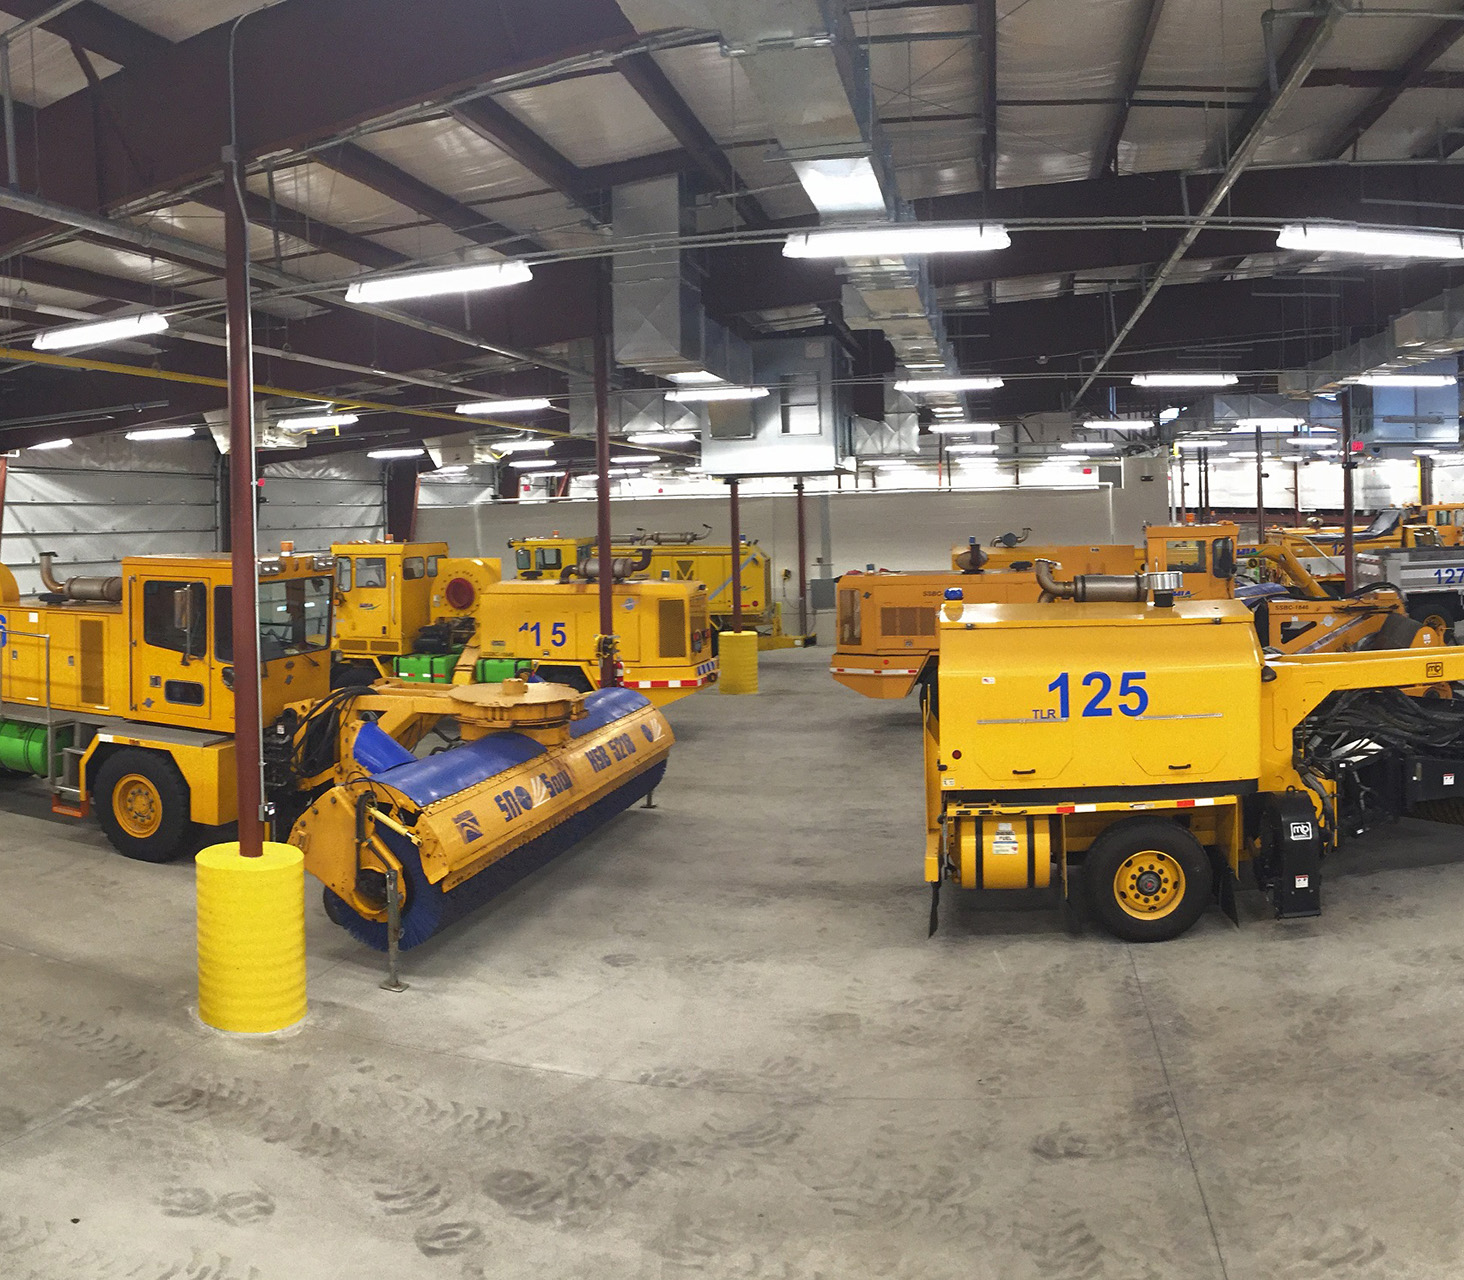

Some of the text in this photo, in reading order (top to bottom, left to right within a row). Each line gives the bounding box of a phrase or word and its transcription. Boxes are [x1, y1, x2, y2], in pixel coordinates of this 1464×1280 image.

[1332, 543, 1345, 556] 12
[1032, 671, 1149, 719] TLR 125
